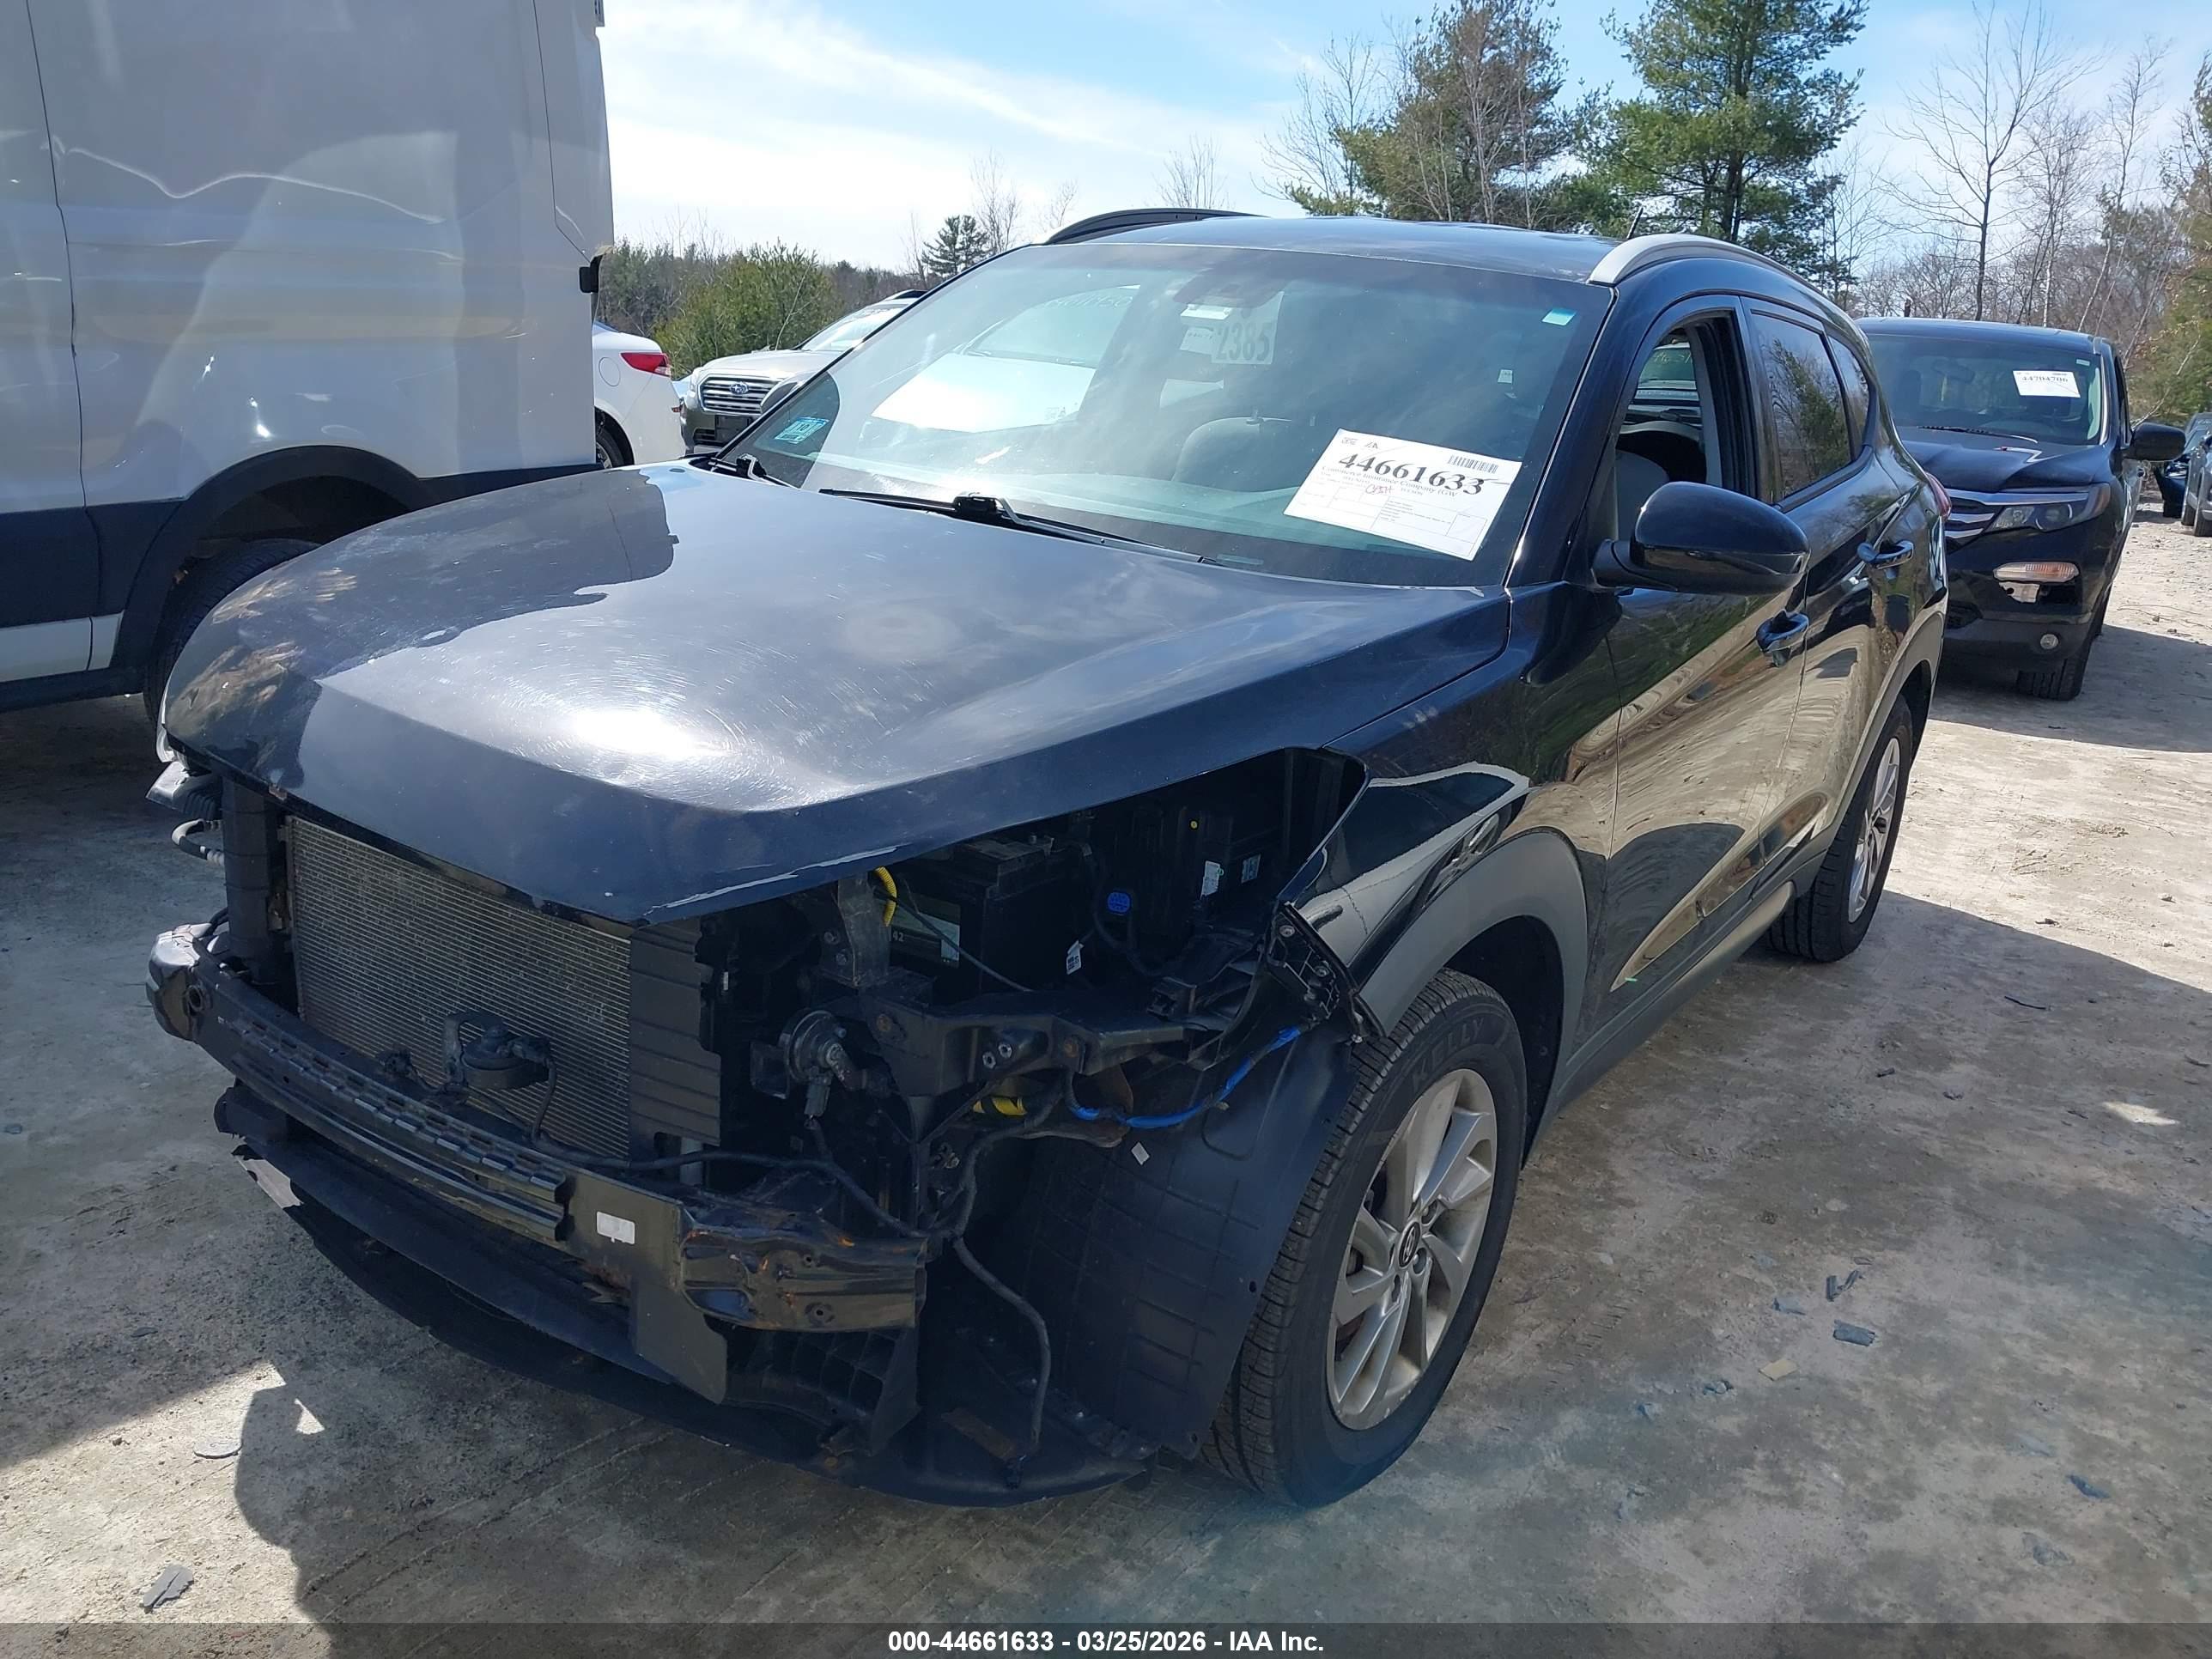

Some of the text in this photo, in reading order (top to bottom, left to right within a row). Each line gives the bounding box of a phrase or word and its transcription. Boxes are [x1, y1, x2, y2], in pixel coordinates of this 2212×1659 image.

[1338, 453, 1486, 495] 44661633
[1363, 472, 1399, 485] Insurance
[1400, 480, 1436, 494] Company
[1412, 1017, 1485, 1091] KELLY
